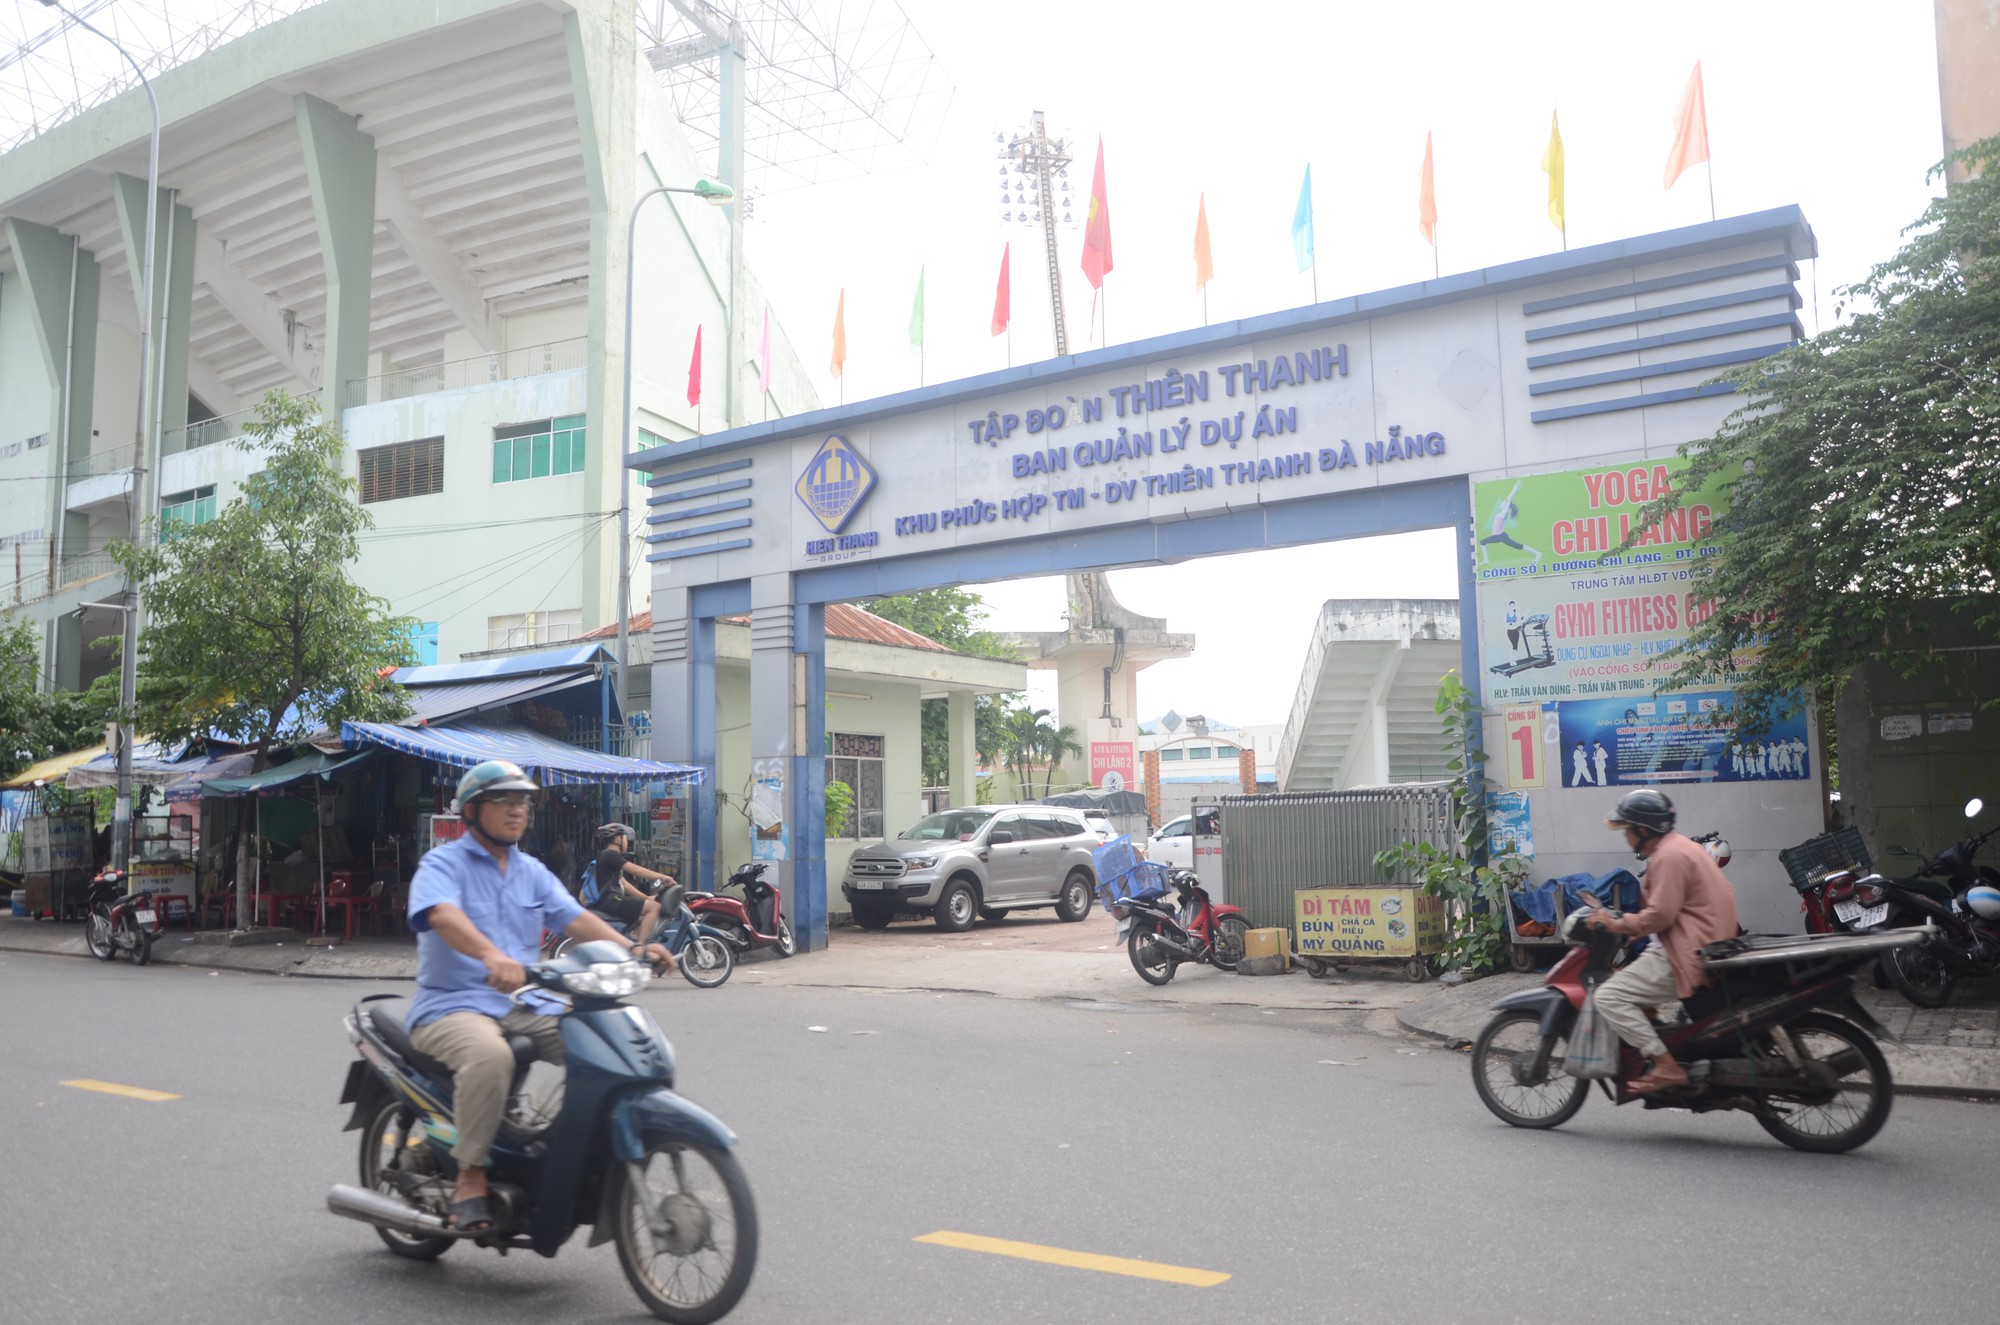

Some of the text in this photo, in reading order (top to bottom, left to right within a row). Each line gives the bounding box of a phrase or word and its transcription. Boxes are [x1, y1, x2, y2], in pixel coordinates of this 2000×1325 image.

[968, 343, 1348, 448] TẬP ĐOÀN THIÊN THANH
[1012, 404, 1297, 479] BAN QUẢN LÝ DỰ ÁN
[895, 512, 937, 536] KHU
[941, 499, 997, 530] PHỨC
[1001, 493, 1047, 522] HỢP
[1053, 486, 1085, 511] TM
[1105, 479, 1136, 503] DV
[1142, 463, 1213, 497] THIÊN
[1219, 452, 1311, 485] THANH
[1318, 439, 1357, 471] ĐÀ
[1365, 425, 1446, 466] NẴNG
[1584, 464, 1674, 509] YOGA
[835, 530, 879, 551] THANH
[1552, 515, 1608, 557] CHI
[820, 551, 857, 563] GROUP
[1542, 564, 1547, 573] 1
[1601, 556, 1623, 567] CHI
[1676, 548, 1695, 559] ĐT:
[1570, 578, 1609, 591] TRUNG
[1612, 574, 1635, 587] TÂM
[1638, 571, 1669, 584] HLĐT
[1672, 569, 1695, 581] VĐV
[1555, 601, 1596, 639] GYM
[1602, 594, 1678, 635] FITNESS
[1641, 642, 1654, 655] HLV
[1598, 661, 1629, 675] CỔNG
[1618, 678, 1645, 691] TRUNG
[1093, 756, 1105, 768] CHI
[1127, 756, 1132, 768] 2
[1511, 725, 1535, 780] 1
[1302, 895, 1372, 917] DÌ TÁM
[1302, 918, 1334, 933] BÚN
[1342, 926, 1364, 935] RIÊU
[1331, 935, 1386, 952] QUẢNG
